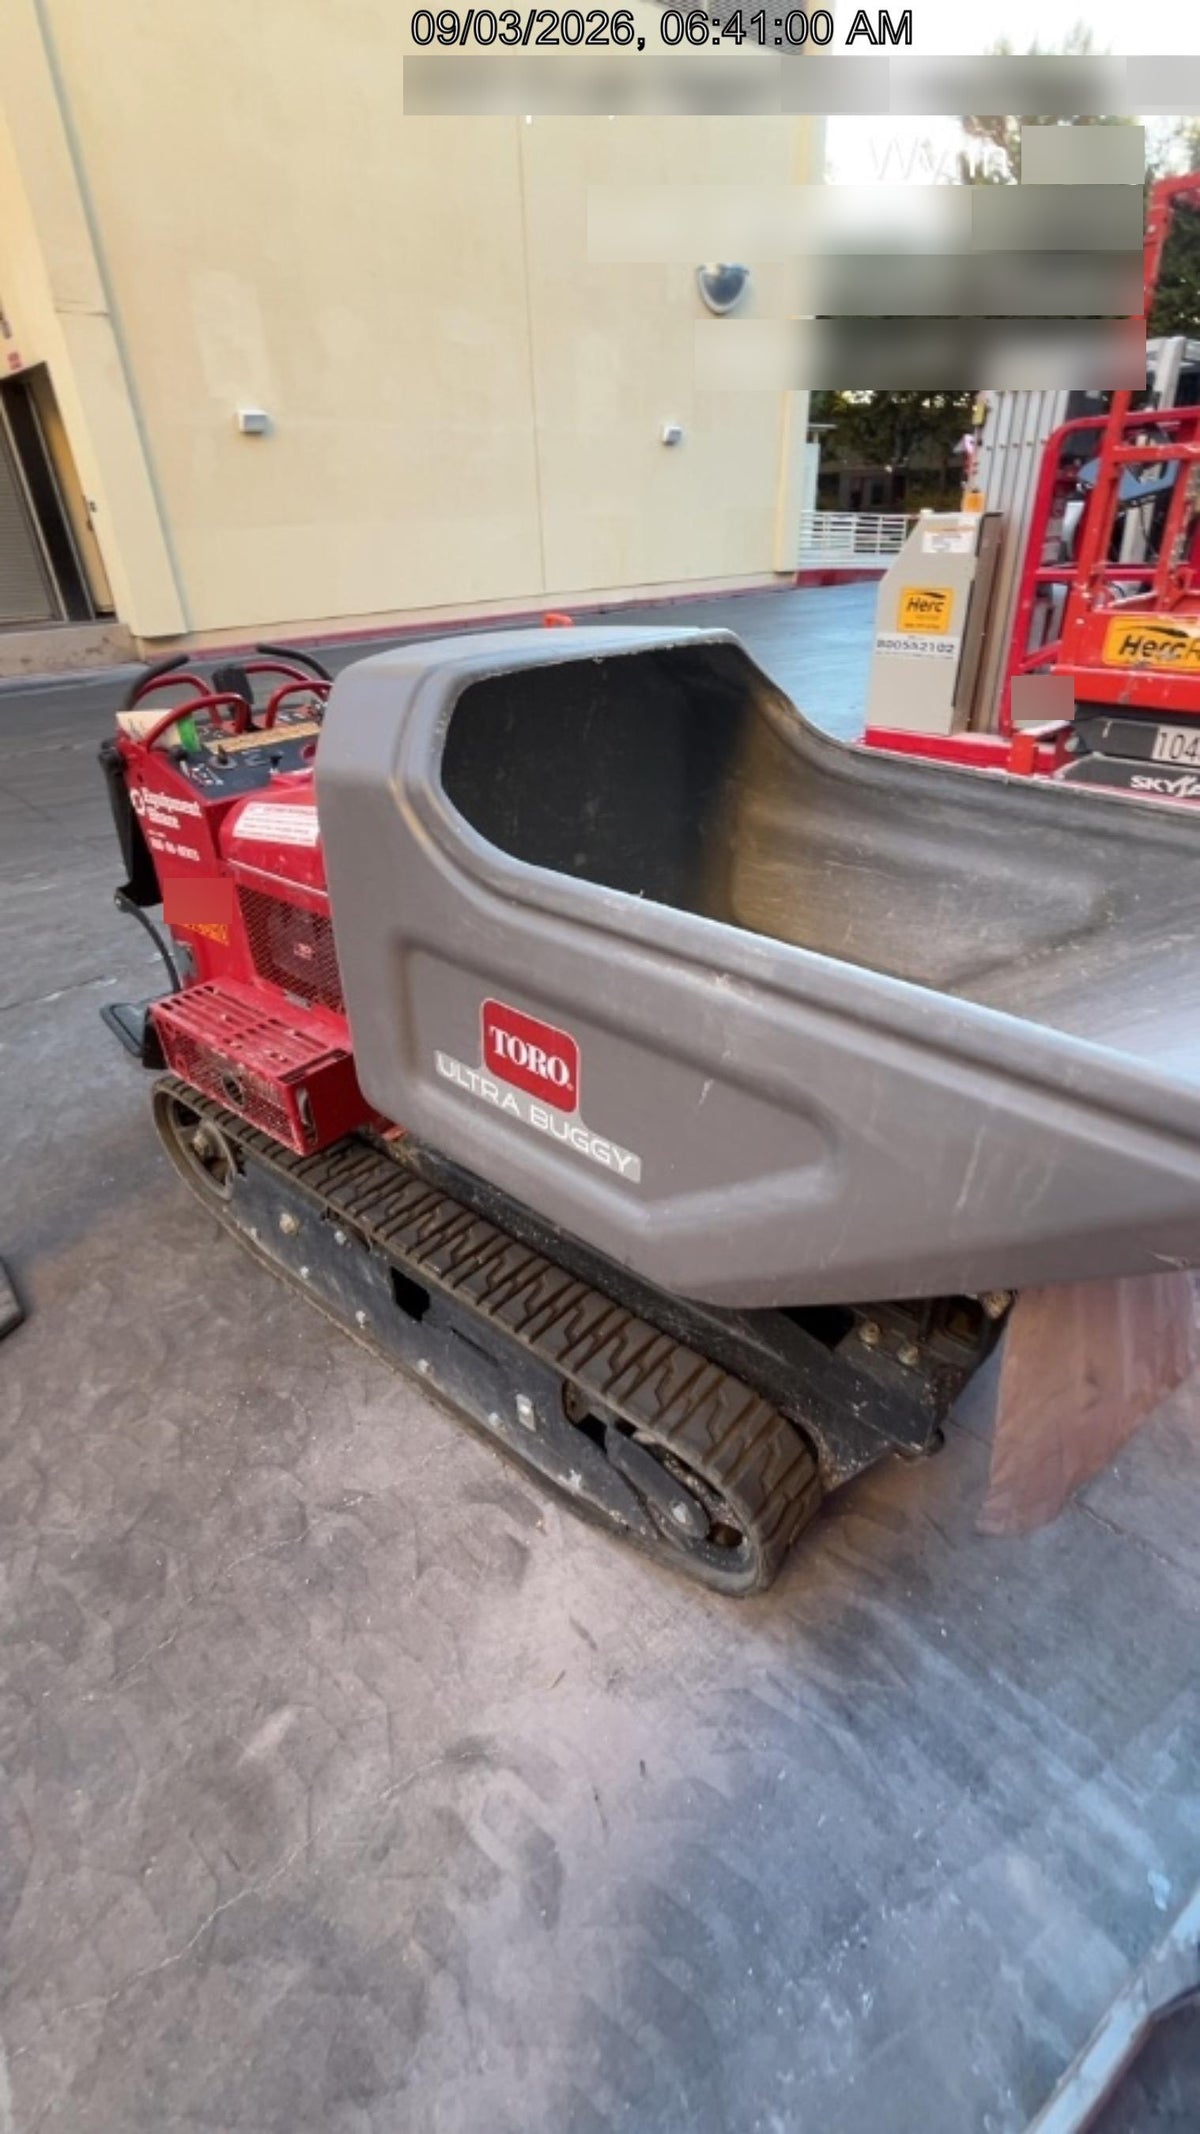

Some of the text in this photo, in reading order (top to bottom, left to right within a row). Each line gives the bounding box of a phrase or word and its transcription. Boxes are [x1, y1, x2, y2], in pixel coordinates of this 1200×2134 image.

[905, 597, 945, 613] Herc
[490, 1026, 570, 1086] TORO
[437, 1056, 632, 1174] ULTRA BUGGY
